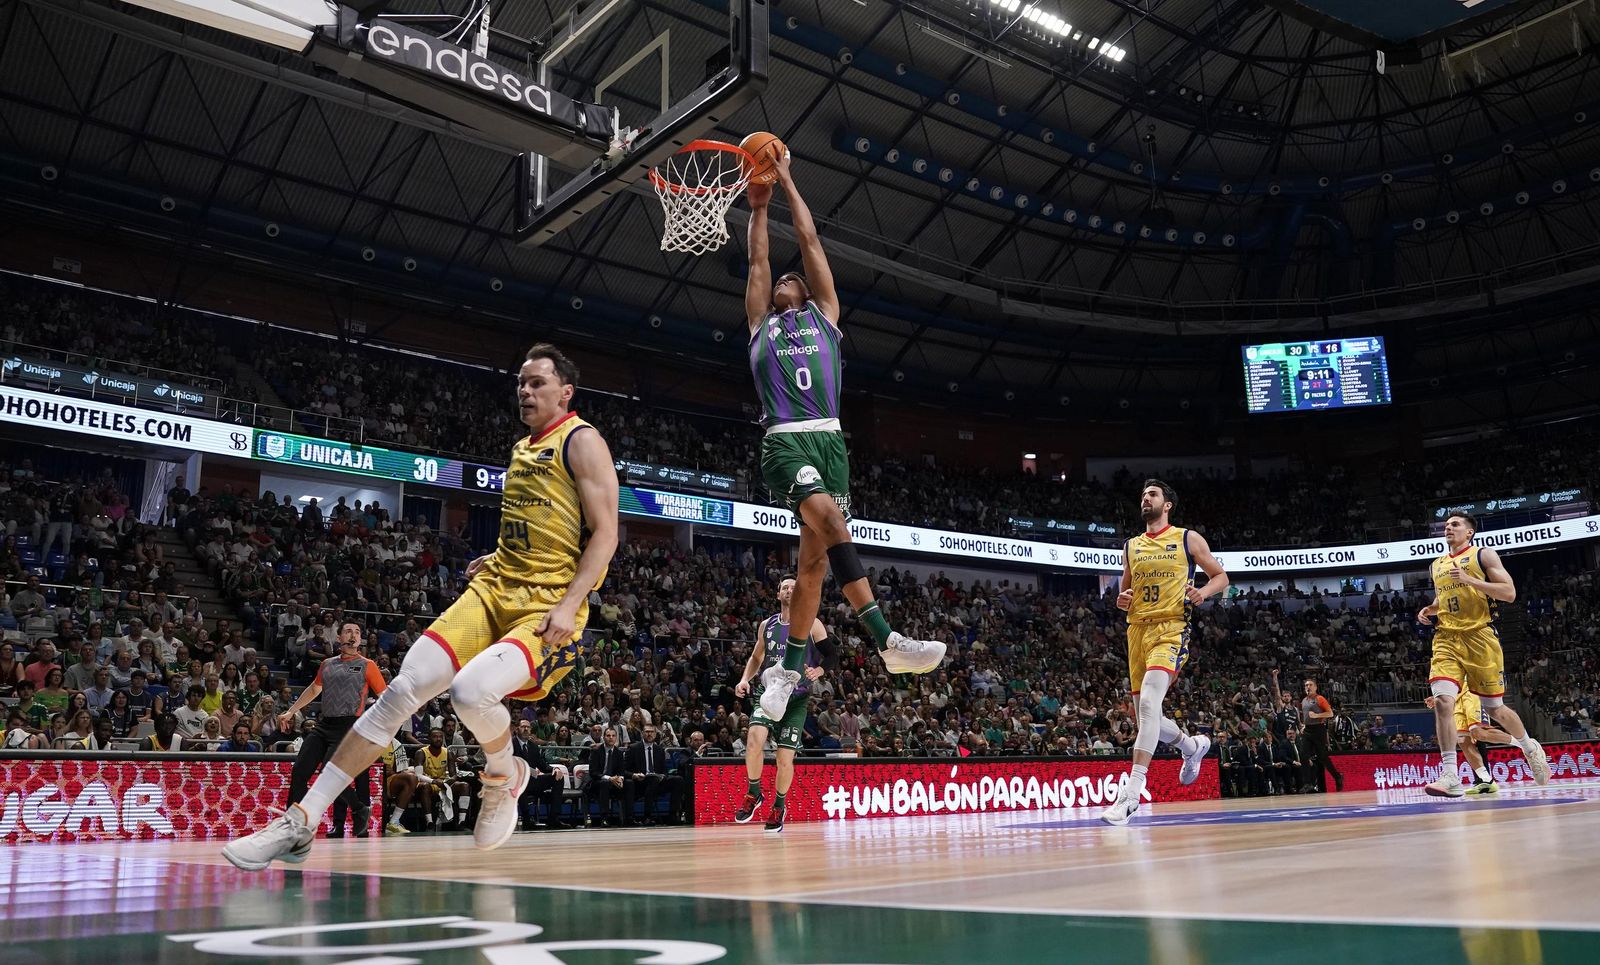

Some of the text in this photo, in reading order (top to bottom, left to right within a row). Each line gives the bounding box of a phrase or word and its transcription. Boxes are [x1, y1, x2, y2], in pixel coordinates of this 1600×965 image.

[367, 24, 552, 116] endesa
[776, 344, 820, 357] málaga
[1290, 346, 1303, 356] 30
[1326, 344, 1338, 353] 16
[24, 362, 62, 379] Unicaja
[795, 366, 812, 391] 0
[1306, 369, 1330, 380] 9:11
[100, 376, 136, 392] Unicaja
[170, 388, 204, 404] Unicaja
[300, 442, 374, 471] UNICAJA
[414, 457, 438, 482] 30
[476, 468, 507, 490] 9:1
[1498, 496, 1527, 505] Fundación
[1551, 488, 1581, 498] Fundación
[1552, 494, 1574, 503] Unicaja
[654, 494, 704, 510] MORABANC
[662, 506, 704, 520] ANDORRA
[753, 510, 787, 528] SOHO
[852, 526, 891, 542] HOTELS
[504, 521, 532, 551] 24
[1410, 542, 1445, 556] SOHO
[1514, 526, 1562, 544] HOTELS
[940, 536, 1033, 558] SOHOHOTELES.COM
[1074, 551, 1100, 564] SOHO
[1137, 554, 1178, 562] MORABANC
[1244, 550, 1356, 568] SOHOHOTELES.COM
[1142, 570, 1176, 578] Andorra
[1142, 584, 1160, 603] 33
[1447, 596, 1460, 613] 13
